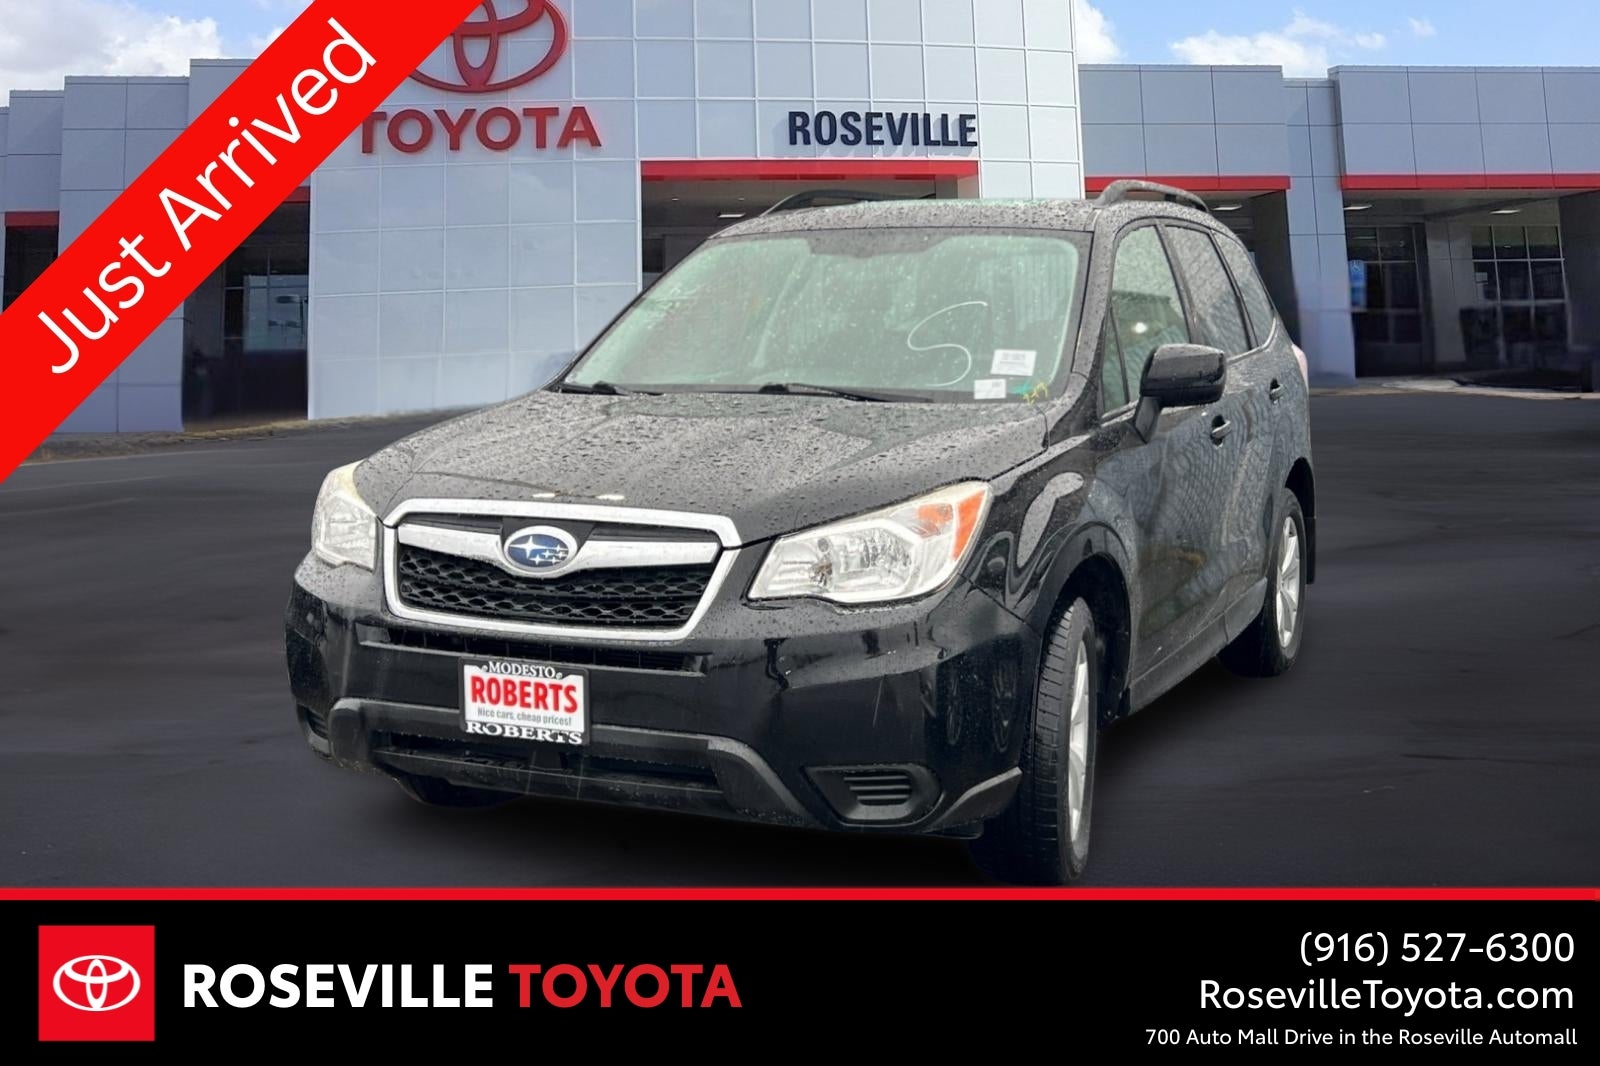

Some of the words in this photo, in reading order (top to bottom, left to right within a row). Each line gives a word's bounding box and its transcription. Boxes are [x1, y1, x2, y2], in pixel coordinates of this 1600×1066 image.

[361, 106, 602, 154] TOYOTA
[788, 110, 978, 148] ROSEVILLE
[488, 660, 556, 680] MODESTO
[471, 675, 579, 714] ROBERTS
[477, 707, 495, 718] Nice
[516, 711, 542, 723] cheap
[465, 721, 583, 745] ROBERTS
